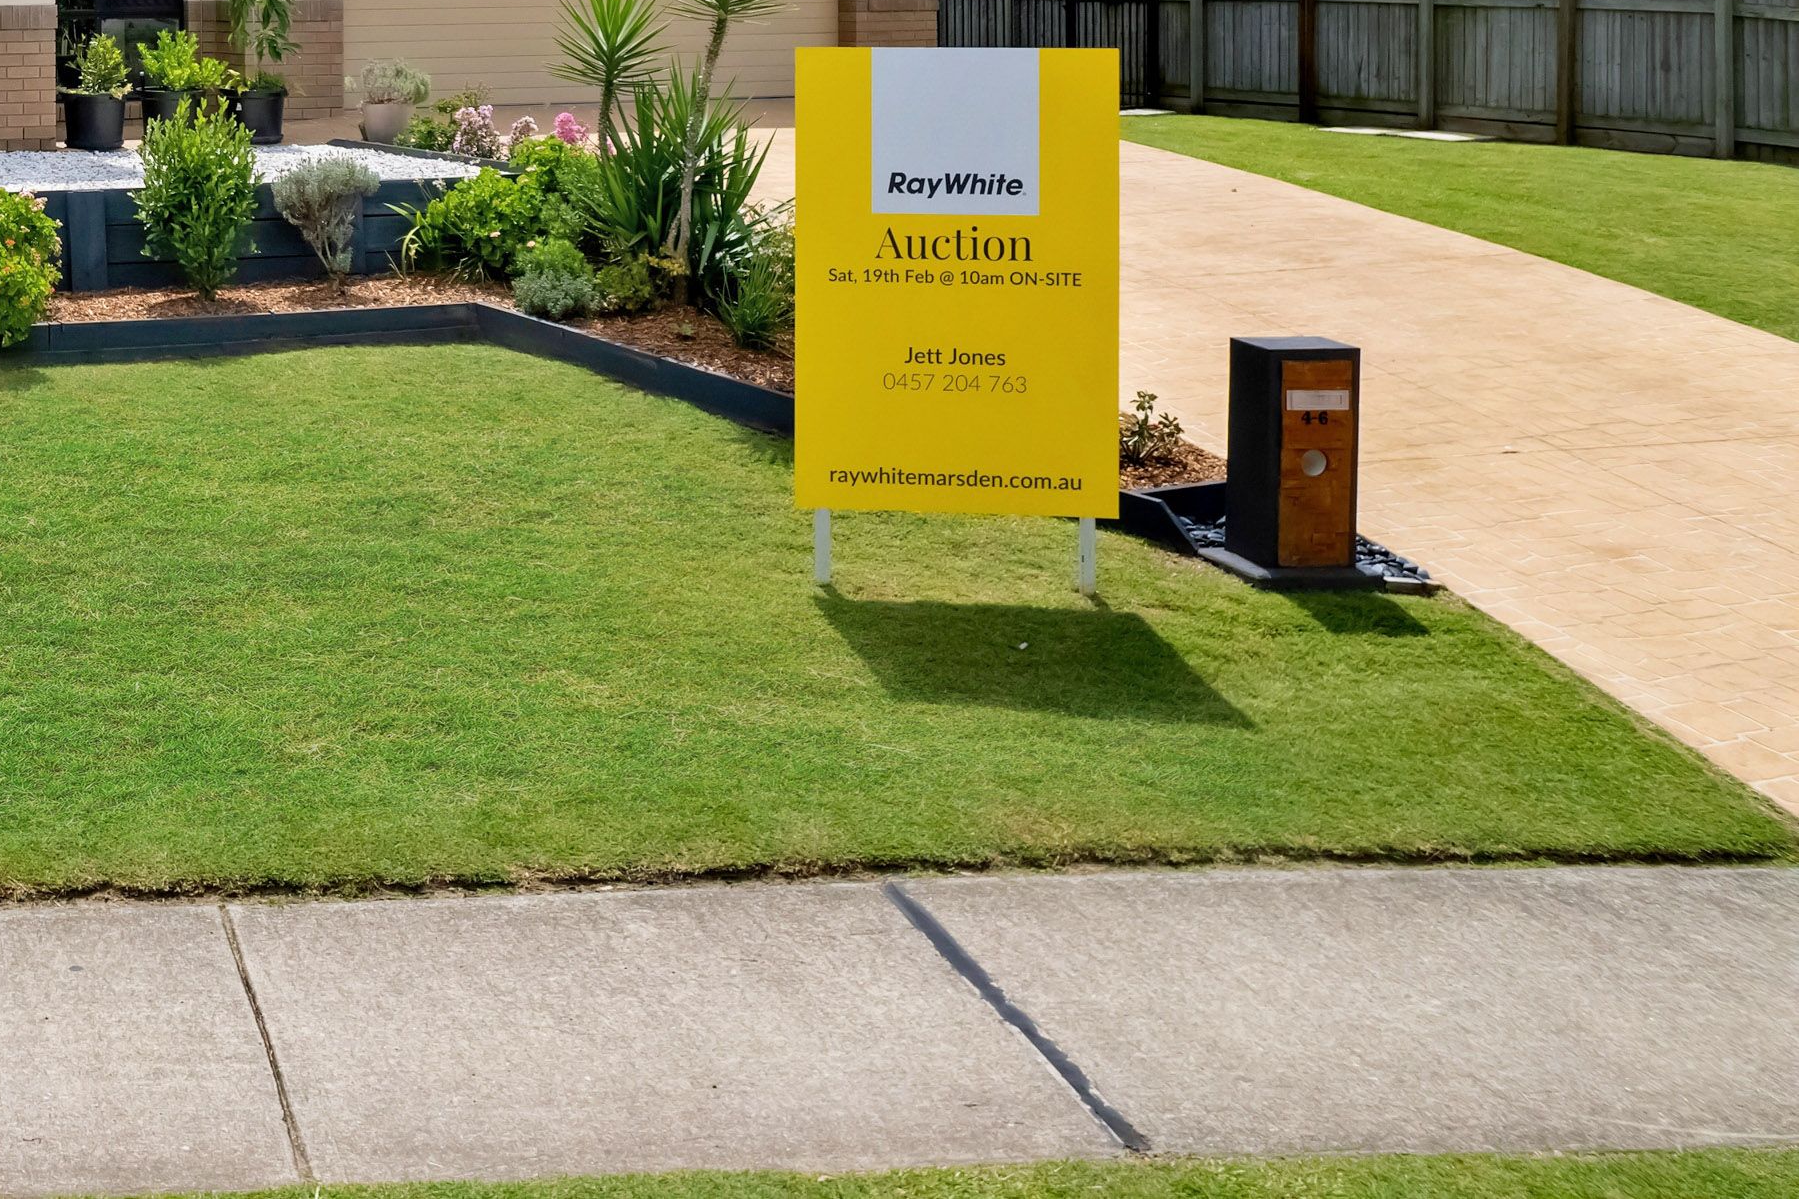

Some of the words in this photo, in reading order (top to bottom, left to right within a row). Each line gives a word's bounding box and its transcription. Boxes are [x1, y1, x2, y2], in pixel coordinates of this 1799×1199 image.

[875, 226, 1034, 262] Auction
[828, 268, 858, 285] Sat,
[863, 268, 900, 283] 19th
[905, 269, 935, 284] Feb
[940, 271, 955, 287] @
[960, 270, 1005, 286] 10am
[1009, 271, 1082, 287] ON-SITE
[904, 347, 943, 365] Jett
[948, 348, 1006, 367] Jones
[883, 373, 935, 391] 0457
[943, 374, 982, 393] 204
[989, 375, 1028, 394] 763
[1301, 410, 1329, 425] 4-6
[829, 466, 1082, 491] raywhitemarsden.com.au
